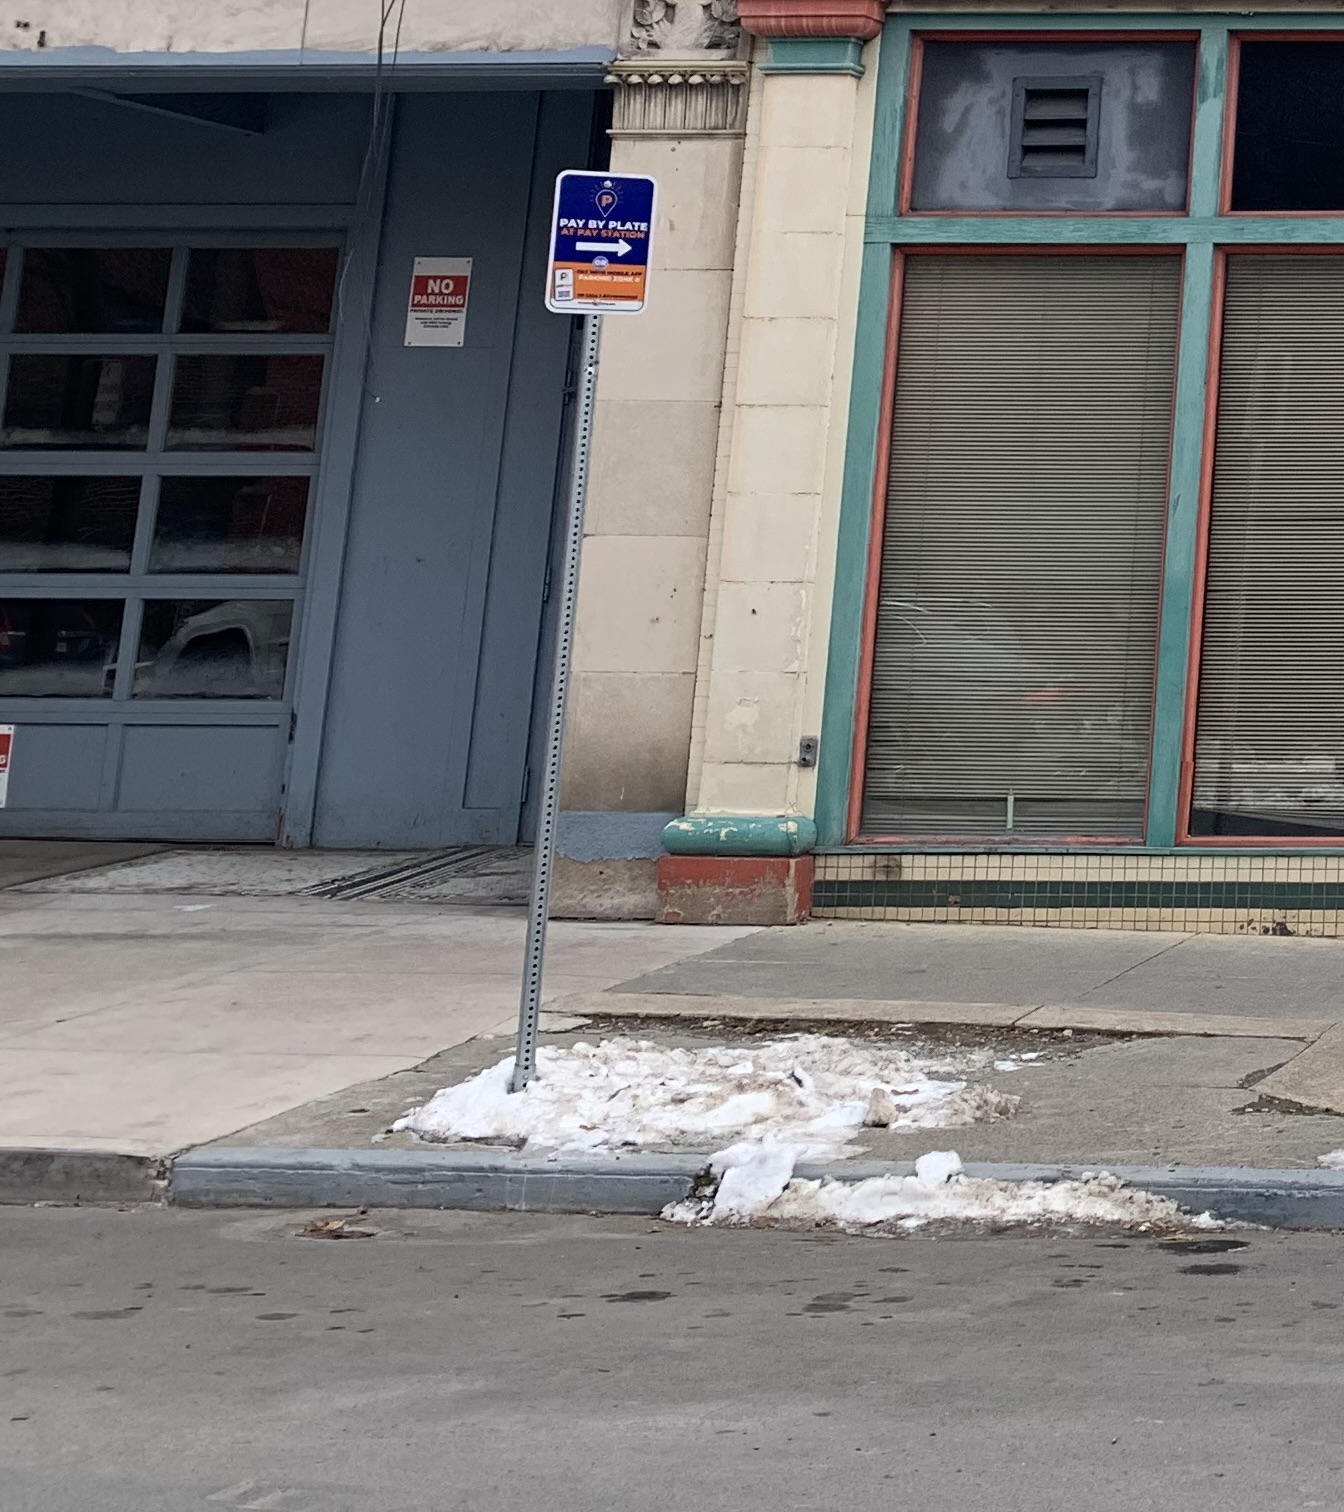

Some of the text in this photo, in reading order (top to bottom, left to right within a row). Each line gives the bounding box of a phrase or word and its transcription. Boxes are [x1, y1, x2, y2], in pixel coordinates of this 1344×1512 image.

[559, 218, 648, 232] PAY BY PLATE
[561, 228, 646, 239] AT PAY STATION
[427, 279, 454, 294] NO
[413, 295, 464, 304] PARKING
